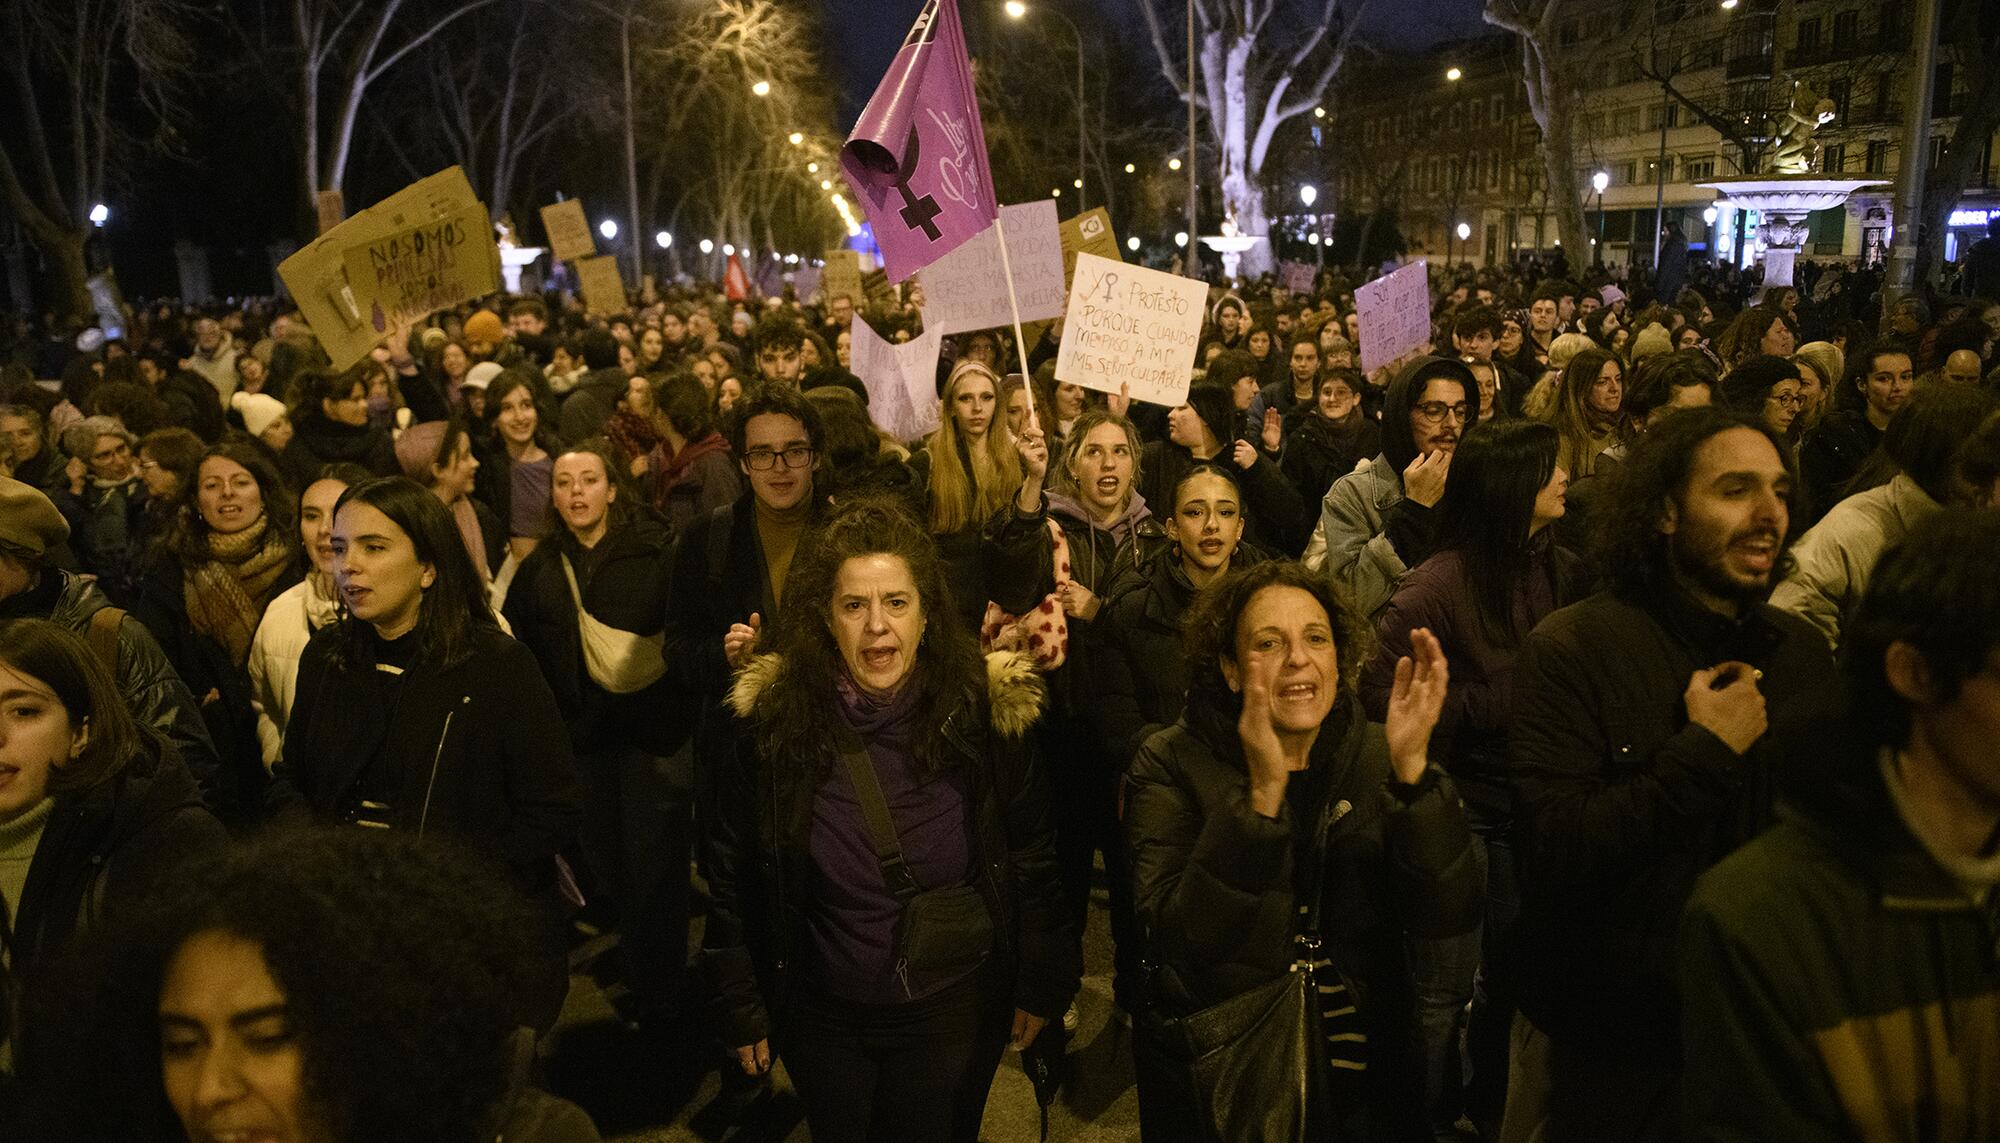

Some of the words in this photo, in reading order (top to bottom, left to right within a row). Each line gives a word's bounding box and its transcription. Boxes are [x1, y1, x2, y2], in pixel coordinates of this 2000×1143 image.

[1129, 282, 1188, 315] PROTESTO
[1074, 327, 1096, 347] ME
[1083, 305, 1140, 334] PORQUE
[1146, 322, 1197, 347] CUANDO
[1071, 351, 1092, 369] ME
[1131, 365, 1186, 390] CULPABLE
